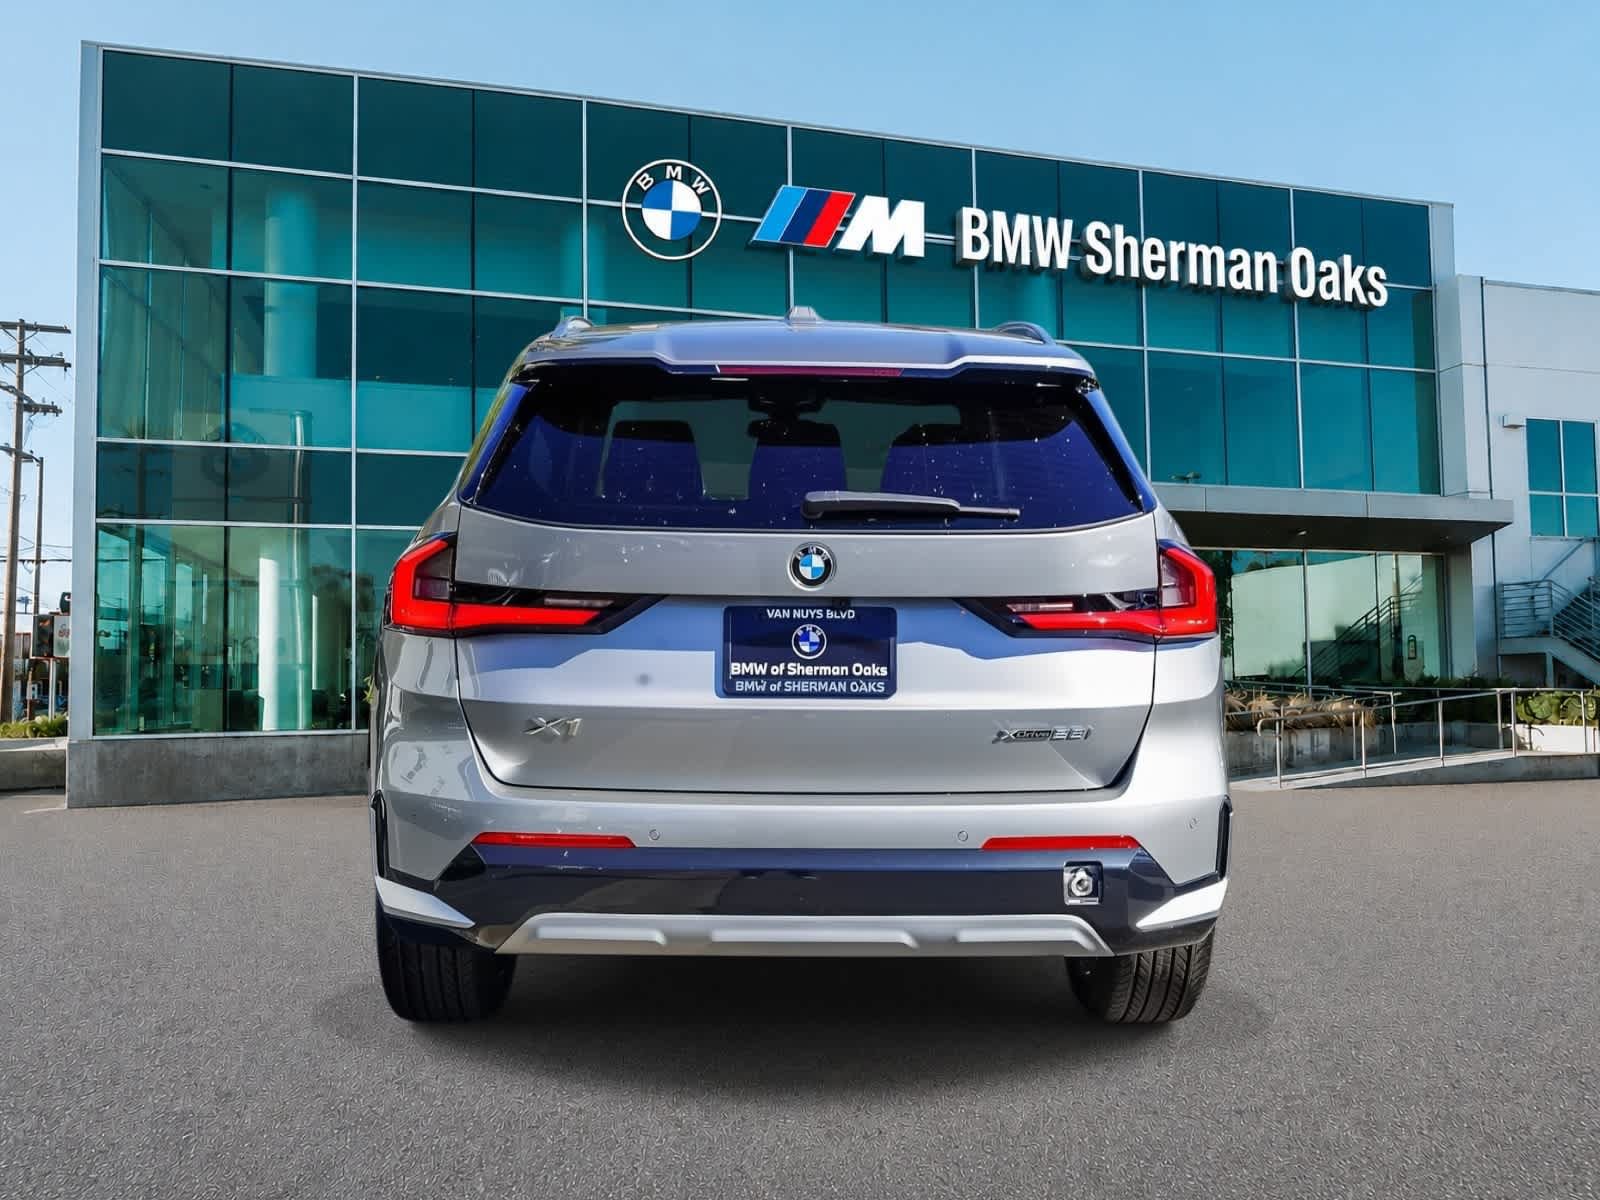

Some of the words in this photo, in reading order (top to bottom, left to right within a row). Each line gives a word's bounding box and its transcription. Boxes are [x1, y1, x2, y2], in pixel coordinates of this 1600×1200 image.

[637, 165, 711, 193] BMW
[960, 206, 1074, 270] BMW
[1084, 220, 1278, 295] Sherman
[1290, 246, 1389, 308] Oaks
[766, 608, 790, 619] VAN
[792, 608, 823, 619] NUYS
[826, 609, 856, 620] BLVD
[731, 662, 768, 676] BMW
[770, 662, 785, 676] of
[787, 662, 849, 676] Sherman
[852, 662, 888, 676] Oaks
[735, 680, 766, 692] BMW
[769, 680, 781, 692] of
[783, 680, 847, 692] SHERMAN
[850, 680, 885, 693] OAKS
[521, 716, 583, 737] X1
